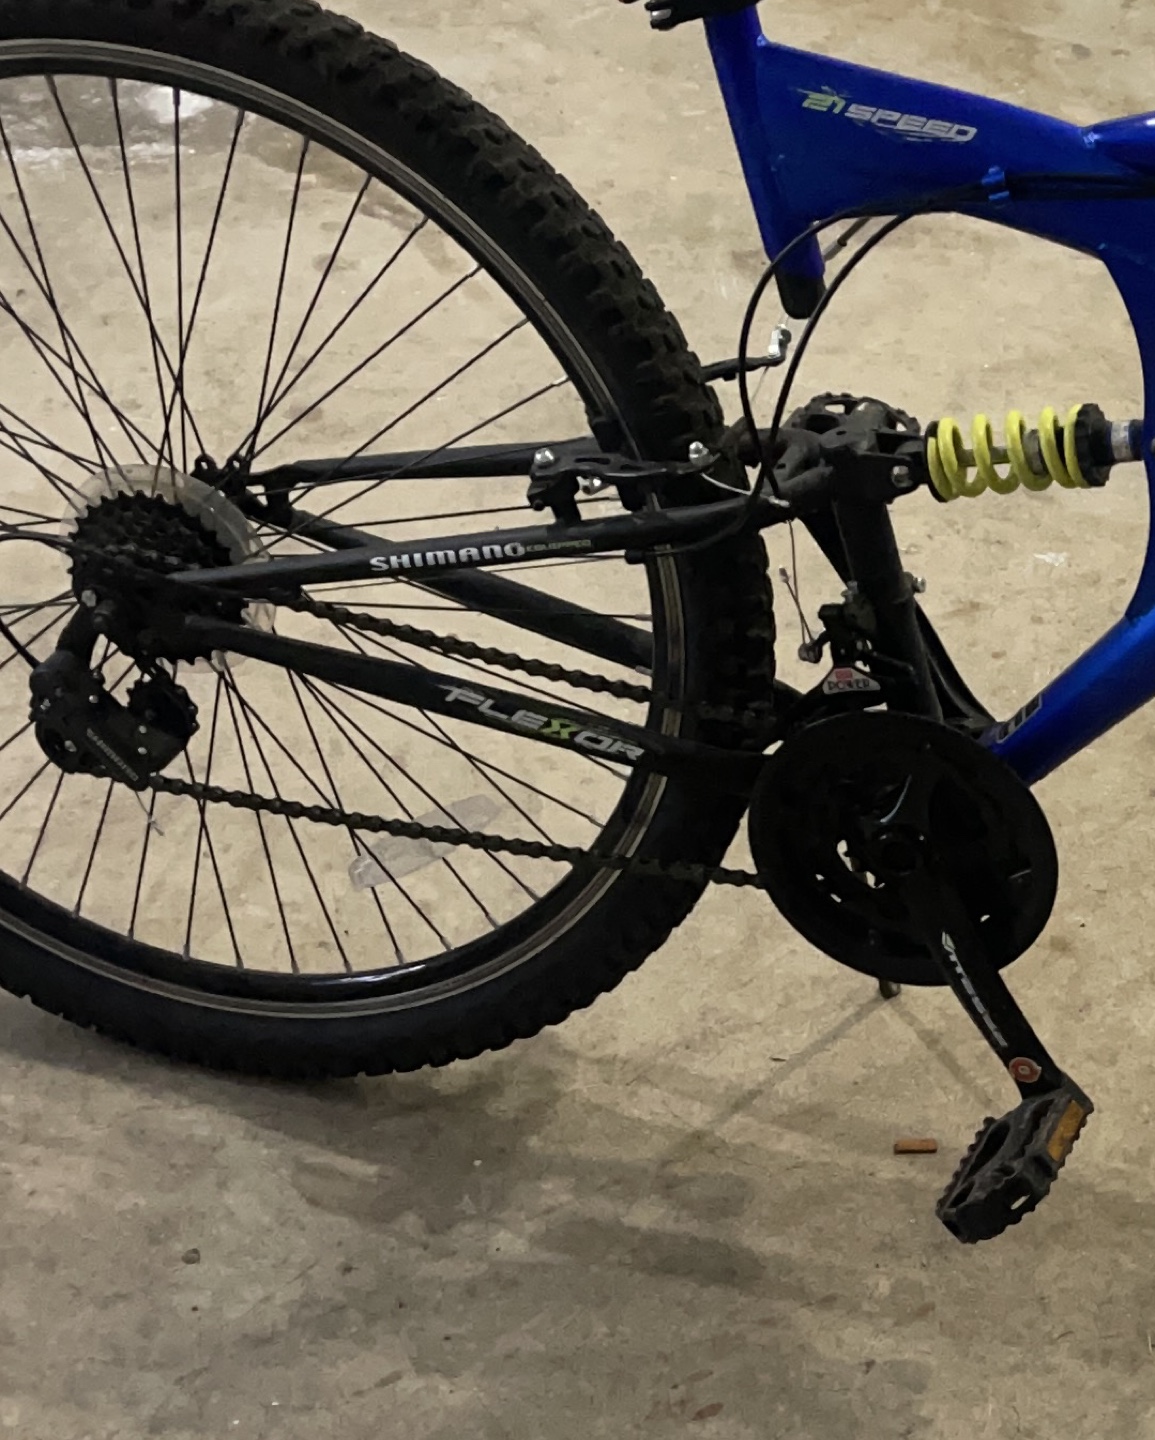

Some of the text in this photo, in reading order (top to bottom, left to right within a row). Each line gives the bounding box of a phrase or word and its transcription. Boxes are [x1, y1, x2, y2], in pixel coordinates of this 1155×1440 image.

[801, 91, 978, 143] 21 SPEED
[368, 541, 526, 572] SHIMANO
[440, 686, 645, 761] FLEXOR
